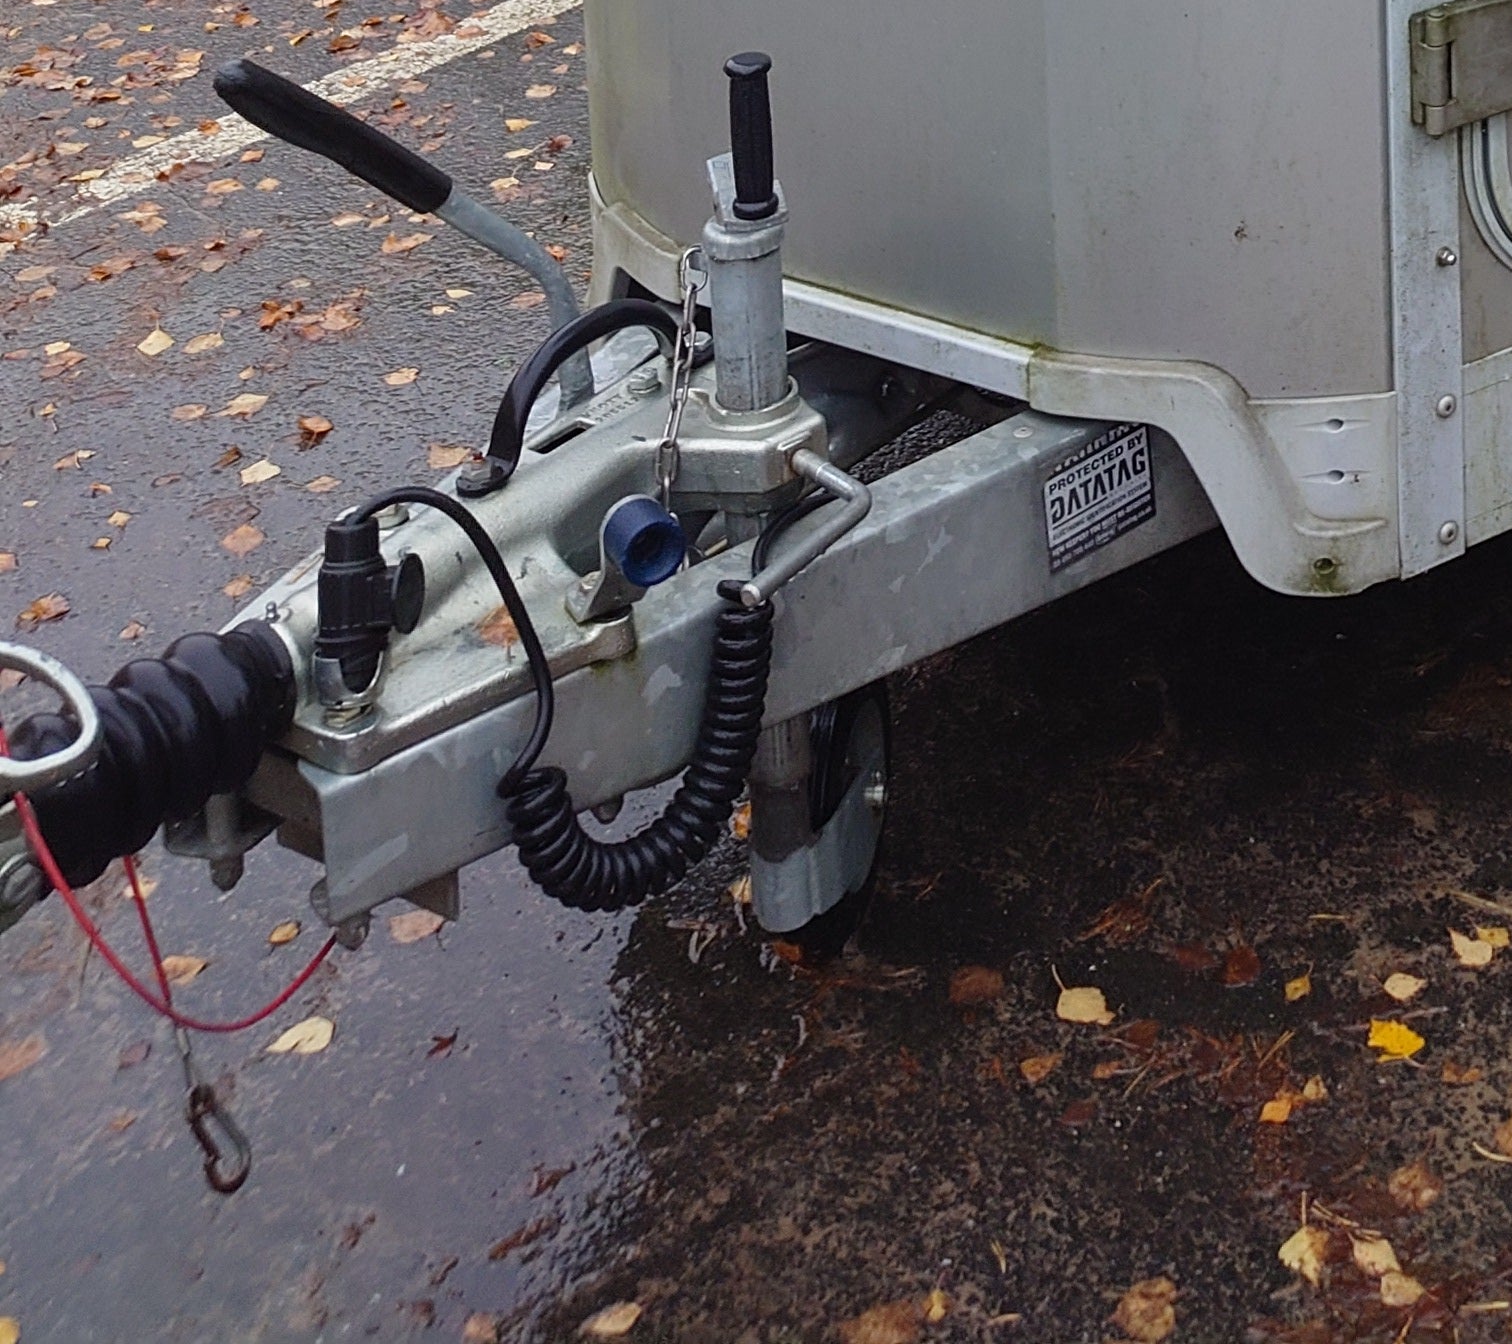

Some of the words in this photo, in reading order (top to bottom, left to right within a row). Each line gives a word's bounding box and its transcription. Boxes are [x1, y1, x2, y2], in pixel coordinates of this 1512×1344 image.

[1049, 445, 1124, 495] PROTECTED
[1127, 432, 1143, 450] BY
[1050, 447, 1146, 524] DATATAG
